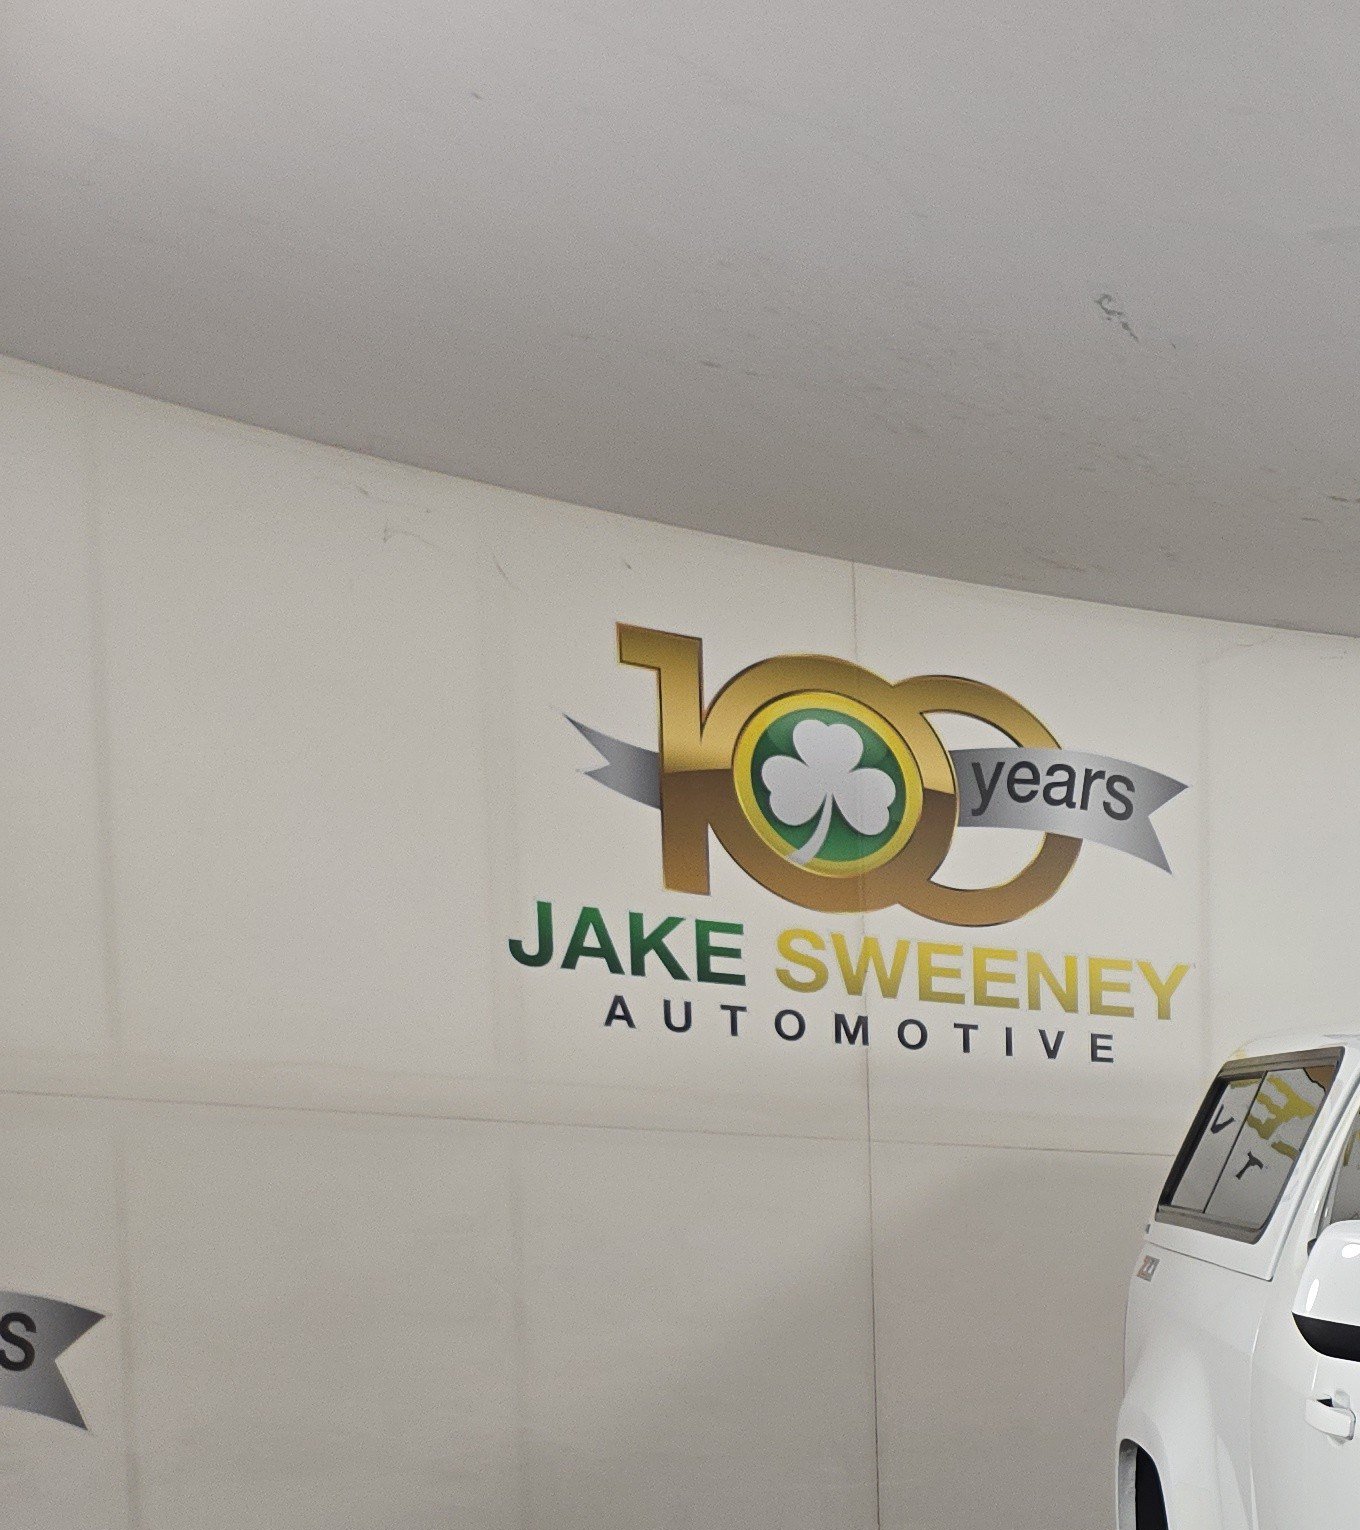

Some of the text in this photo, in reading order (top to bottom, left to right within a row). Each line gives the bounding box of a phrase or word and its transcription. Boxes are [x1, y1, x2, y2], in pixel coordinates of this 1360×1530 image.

[970, 759, 1137, 821] years
[507, 901, 1190, 1020] JAKE SWEENEY
[604, 995, 1114, 1064] AUTOMOTIVE
